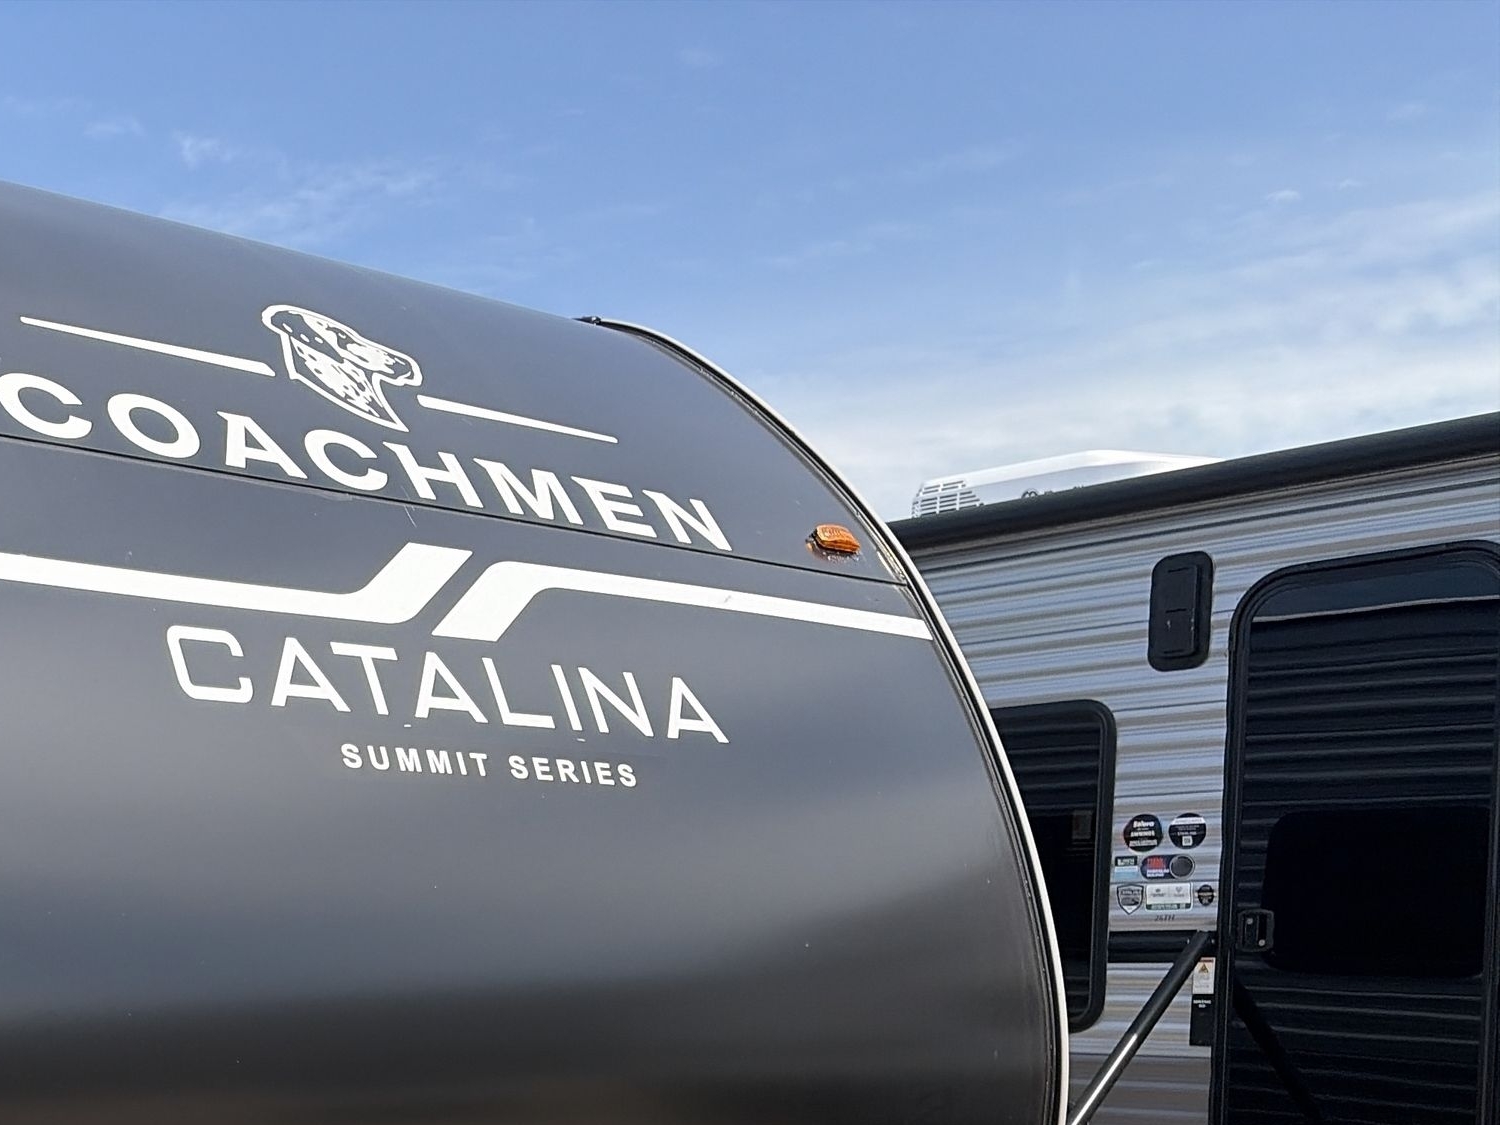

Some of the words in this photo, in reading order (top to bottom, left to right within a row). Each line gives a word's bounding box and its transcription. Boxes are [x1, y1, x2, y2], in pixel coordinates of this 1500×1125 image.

[166, 624, 729, 745] CATALINA
[341, 743, 490, 778] SUMMIT
[508, 755, 638, 788] SERIES
